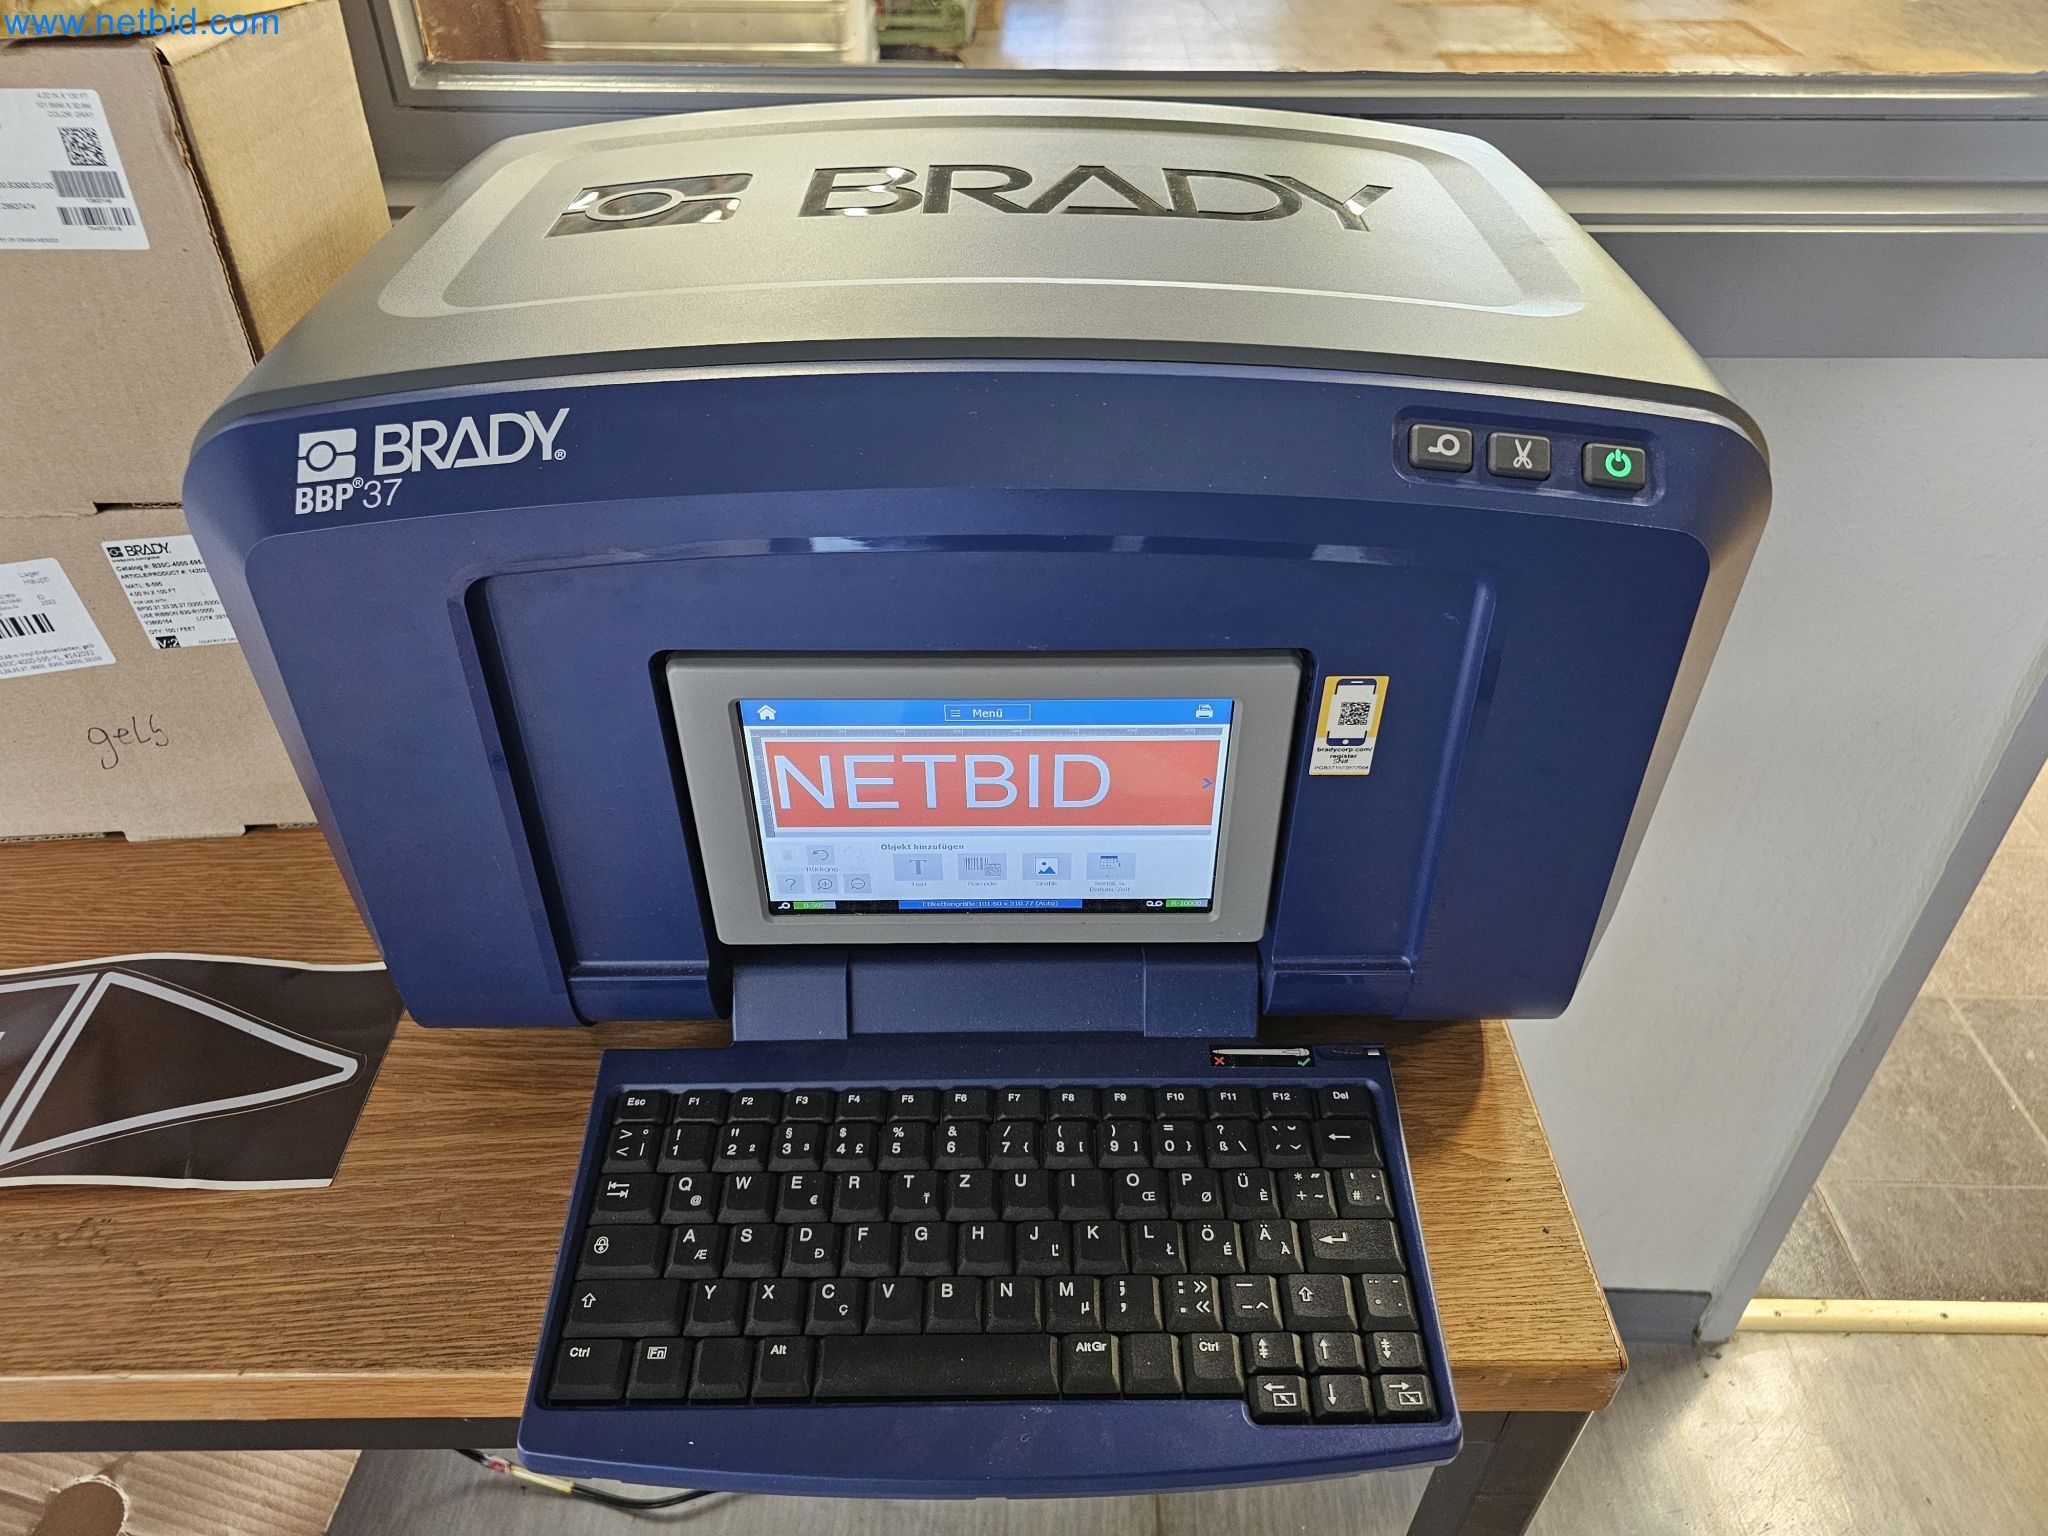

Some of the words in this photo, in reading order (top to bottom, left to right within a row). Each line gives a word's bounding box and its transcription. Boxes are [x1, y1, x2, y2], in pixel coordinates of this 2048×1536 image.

[798, 164, 1394, 232] BRADY
[362, 478, 403, 509] 37
[972, 708, 1003, 718] Menü
[773, 754, 1111, 809] NETBID
[914, 843, 964, 851] hinzufügen
[626, 1098, 646, 1106] Esc
[688, 1098, 700, 1106] F1
[742, 1096, 754, 1106] F2
[796, 1096, 808, 1104] F3
[848, 1094, 860, 1104] F4
[902, 1094, 914, 1102] F5
[954, 1094, 968, 1102] F6
[1008, 1094, 1020, 1102] F7
[1062, 1094, 1074, 1102] F8
[1114, 1092, 1126, 1102] F9
[1166, 1092, 1184, 1100] F10
[1220, 1092, 1236, 1100] F11
[1272, 1092, 1290, 1100] F12
[1332, 1092, 1348, 1100] Del
[672, 1144, 678, 1156] 1
[726, 1144, 736, 1156] 2
[782, 1142, 792, 1154] 3
[836, 1144, 846, 1154] 4
[892, 1142, 900, 1154] 5
[946, 1142, 956, 1152] 6
[1002, 1142, 1010, 1152] 7
[1056, 1140, 1064, 1152] 8
[1110, 1140, 1118, 1152] 9
[678, 1176, 692, 1192] Q
[736, 1176, 752, 1190] W
[792, 1176, 802, 1188] E
[848, 1176, 860, 1188] R
[904, 1174, 914, 1188] T
[960, 1174, 970, 1188] Z
[1014, 1174, 1026, 1186] U
[1126, 1174, 1140, 1186] O
[1182, 1174, 1192, 1186] P
[1238, 1172, 1248, 1188] Ü
[682, 1228, 696, 1242] A
[740, 1228, 752, 1242] S
[800, 1228, 812, 1242] D
[858, 1228, 868, 1242] F
[914, 1226, 928, 1240] G
[972, 1226, 984, 1240] H
[1030, 1226, 1038, 1240] J
[1088, 1226, 1100, 1240] K
[1144, 1224, 1154, 1238] L
[1202, 1224, 1214, 1242] Ö
[1260, 1224, 1272, 1240] Ä
[704, 1284, 716, 1300] Y
[762, 1284, 776, 1300] X
[822, 1284, 836, 1298] C
[882, 1284, 894, 1298] V
[942, 1284, 954, 1298] B
[1000, 1282, 1012, 1296] N
[1060, 1282, 1074, 1296] M
[570, 1348, 590, 1358] Ctrl
[770, 1344, 786, 1354] Alt
[1076, 1342, 1106, 1352] AltGr
[1198, 1340, 1220, 1352] Ctrl
